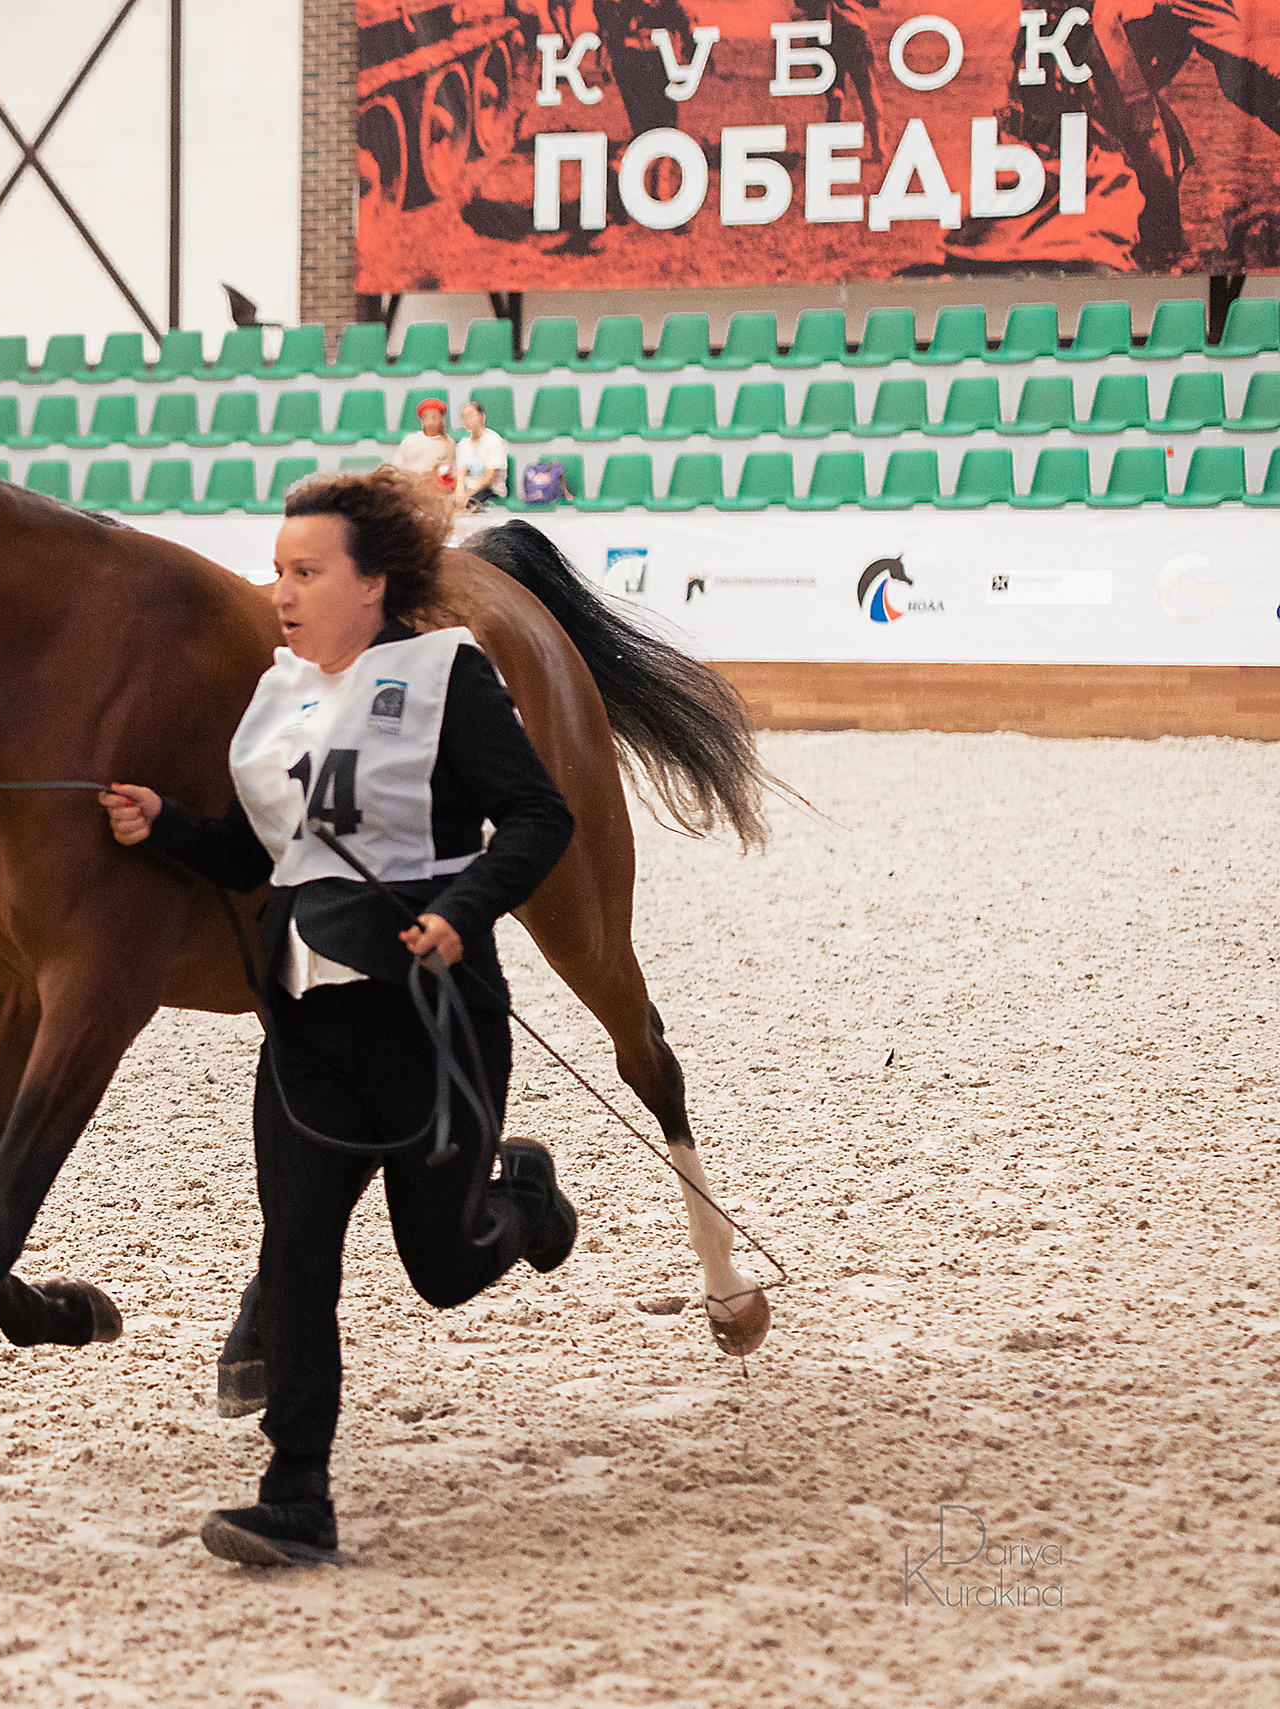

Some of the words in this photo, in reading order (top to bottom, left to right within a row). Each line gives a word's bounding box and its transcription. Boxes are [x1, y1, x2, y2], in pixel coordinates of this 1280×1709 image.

[535, 6, 1092, 107] КУБОК
[533, 112, 1088, 231] ПОБЕДЫ
[287, 748, 363, 840] 14
